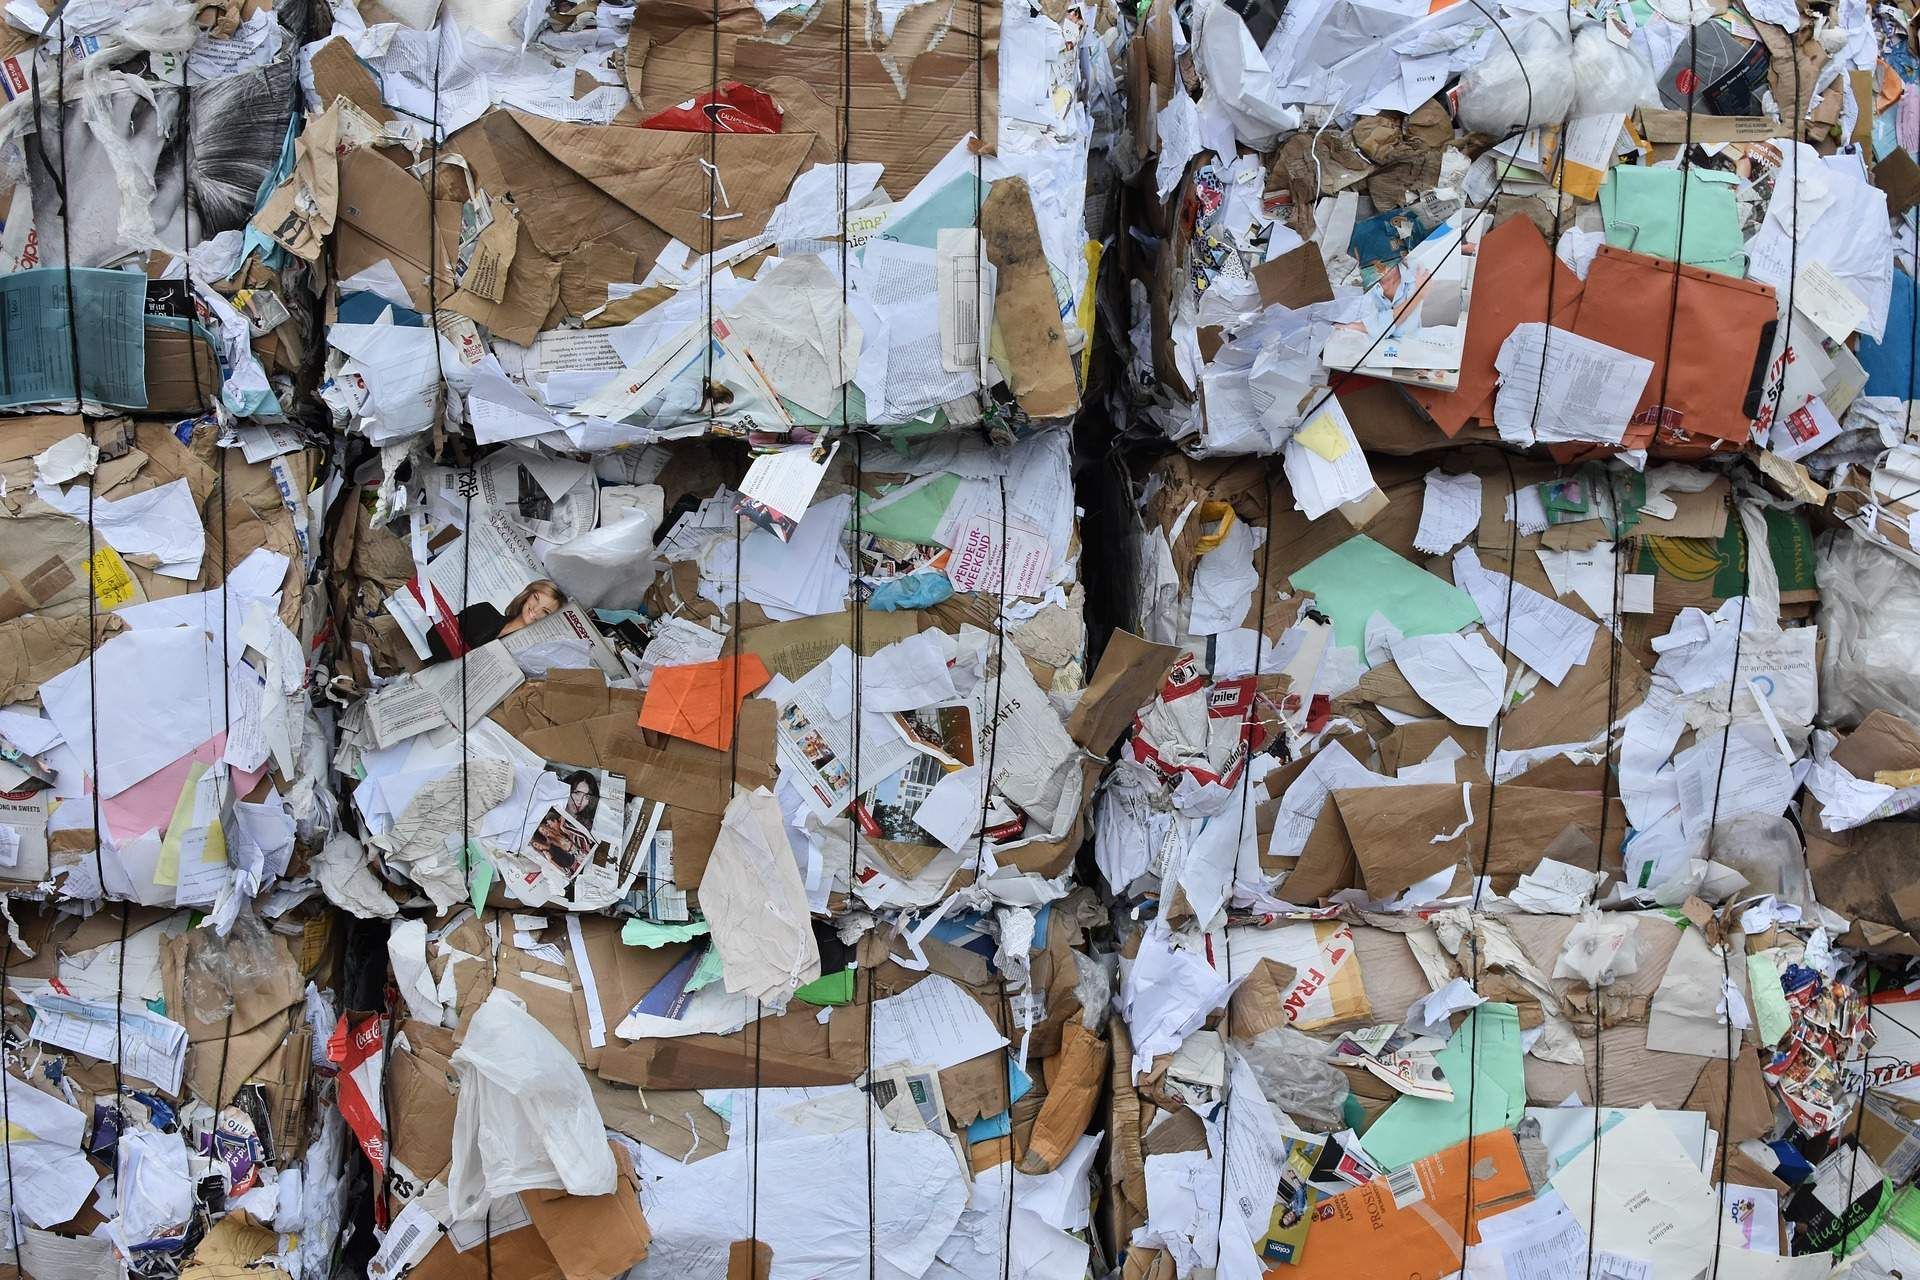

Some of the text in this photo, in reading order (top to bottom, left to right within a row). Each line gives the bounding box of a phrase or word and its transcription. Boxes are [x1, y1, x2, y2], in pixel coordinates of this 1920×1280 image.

[488, 516, 517, 554] SUCCESS
[955, 527, 982, 584] PENDEUR-
[964, 534, 992, 591] WEEKEND
[18, 804, 41, 813] SWEETS
